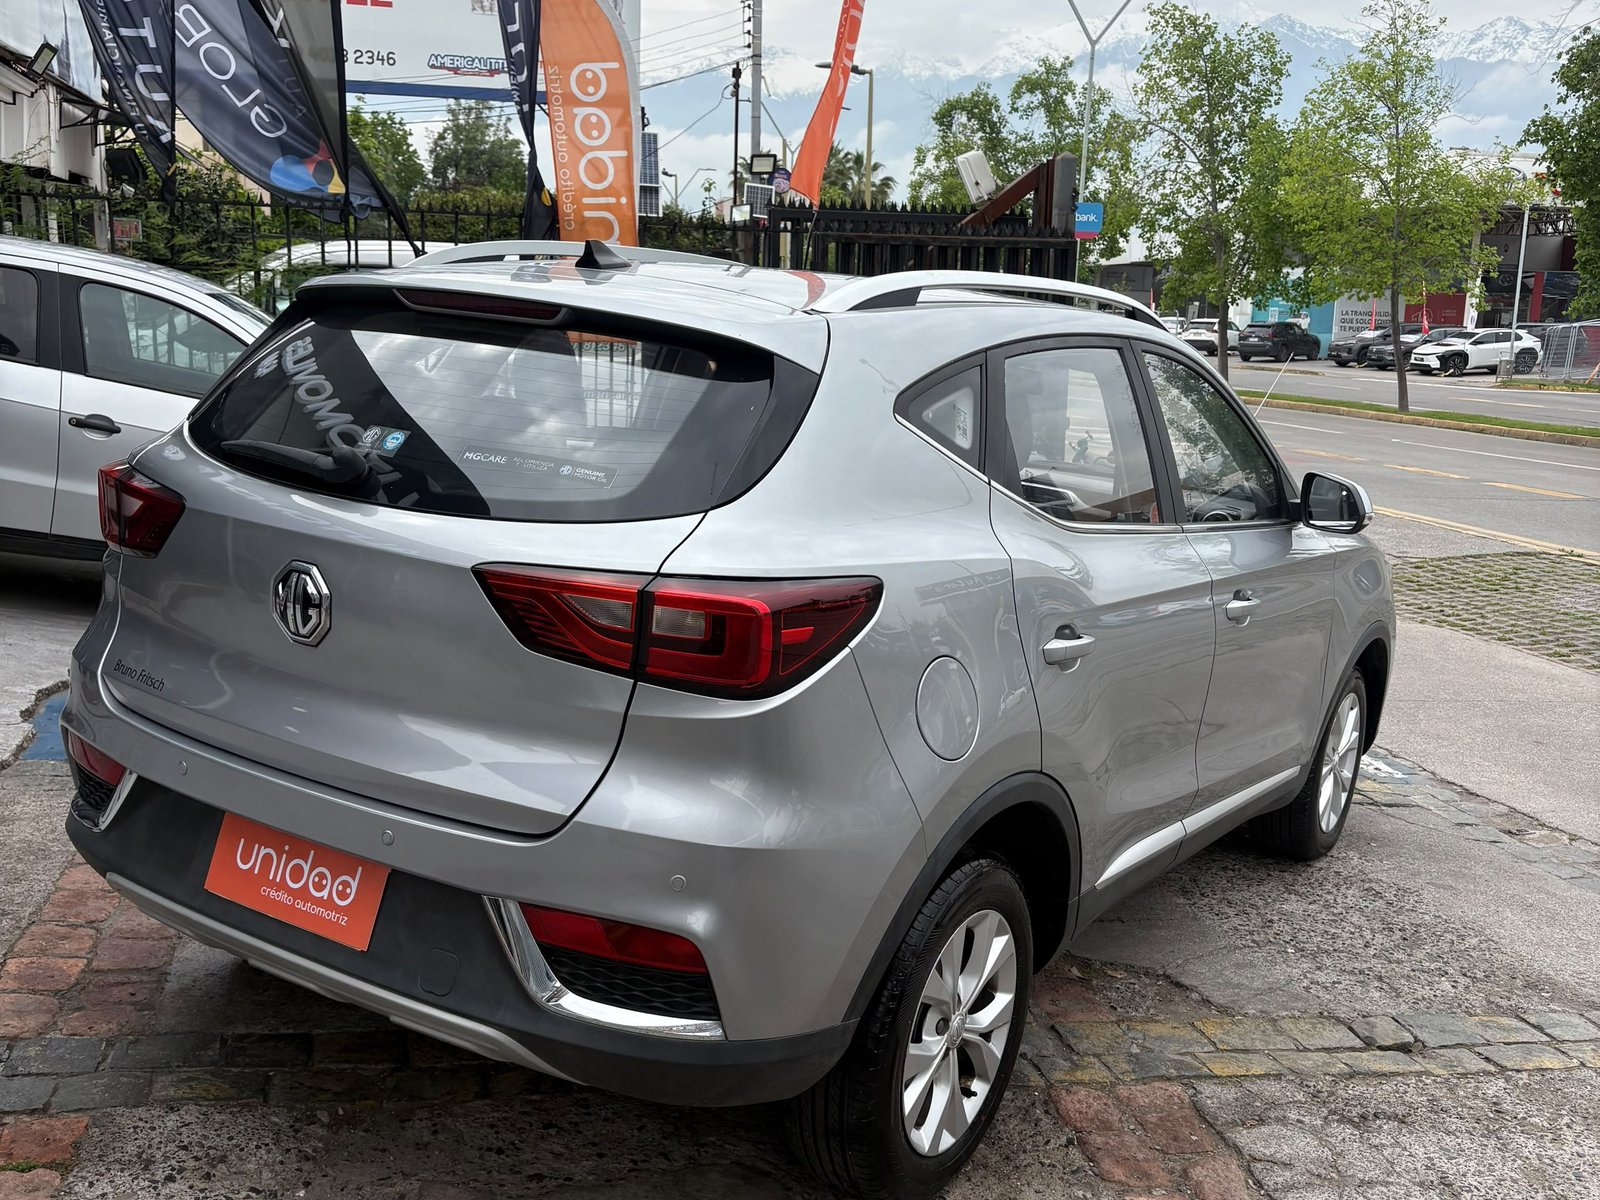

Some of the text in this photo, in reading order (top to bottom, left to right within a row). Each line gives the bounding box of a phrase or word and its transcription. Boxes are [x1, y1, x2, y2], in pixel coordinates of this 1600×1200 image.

[353, 49, 396, 66] 2346
[575, 467, 606, 478] GENUINE
[275, 566, 325, 638] MG
[113, 658, 165, 692] Bruno Fritsch
[236, 838, 362, 906] unidad
[260, 885, 349, 926] crédito automotriz
